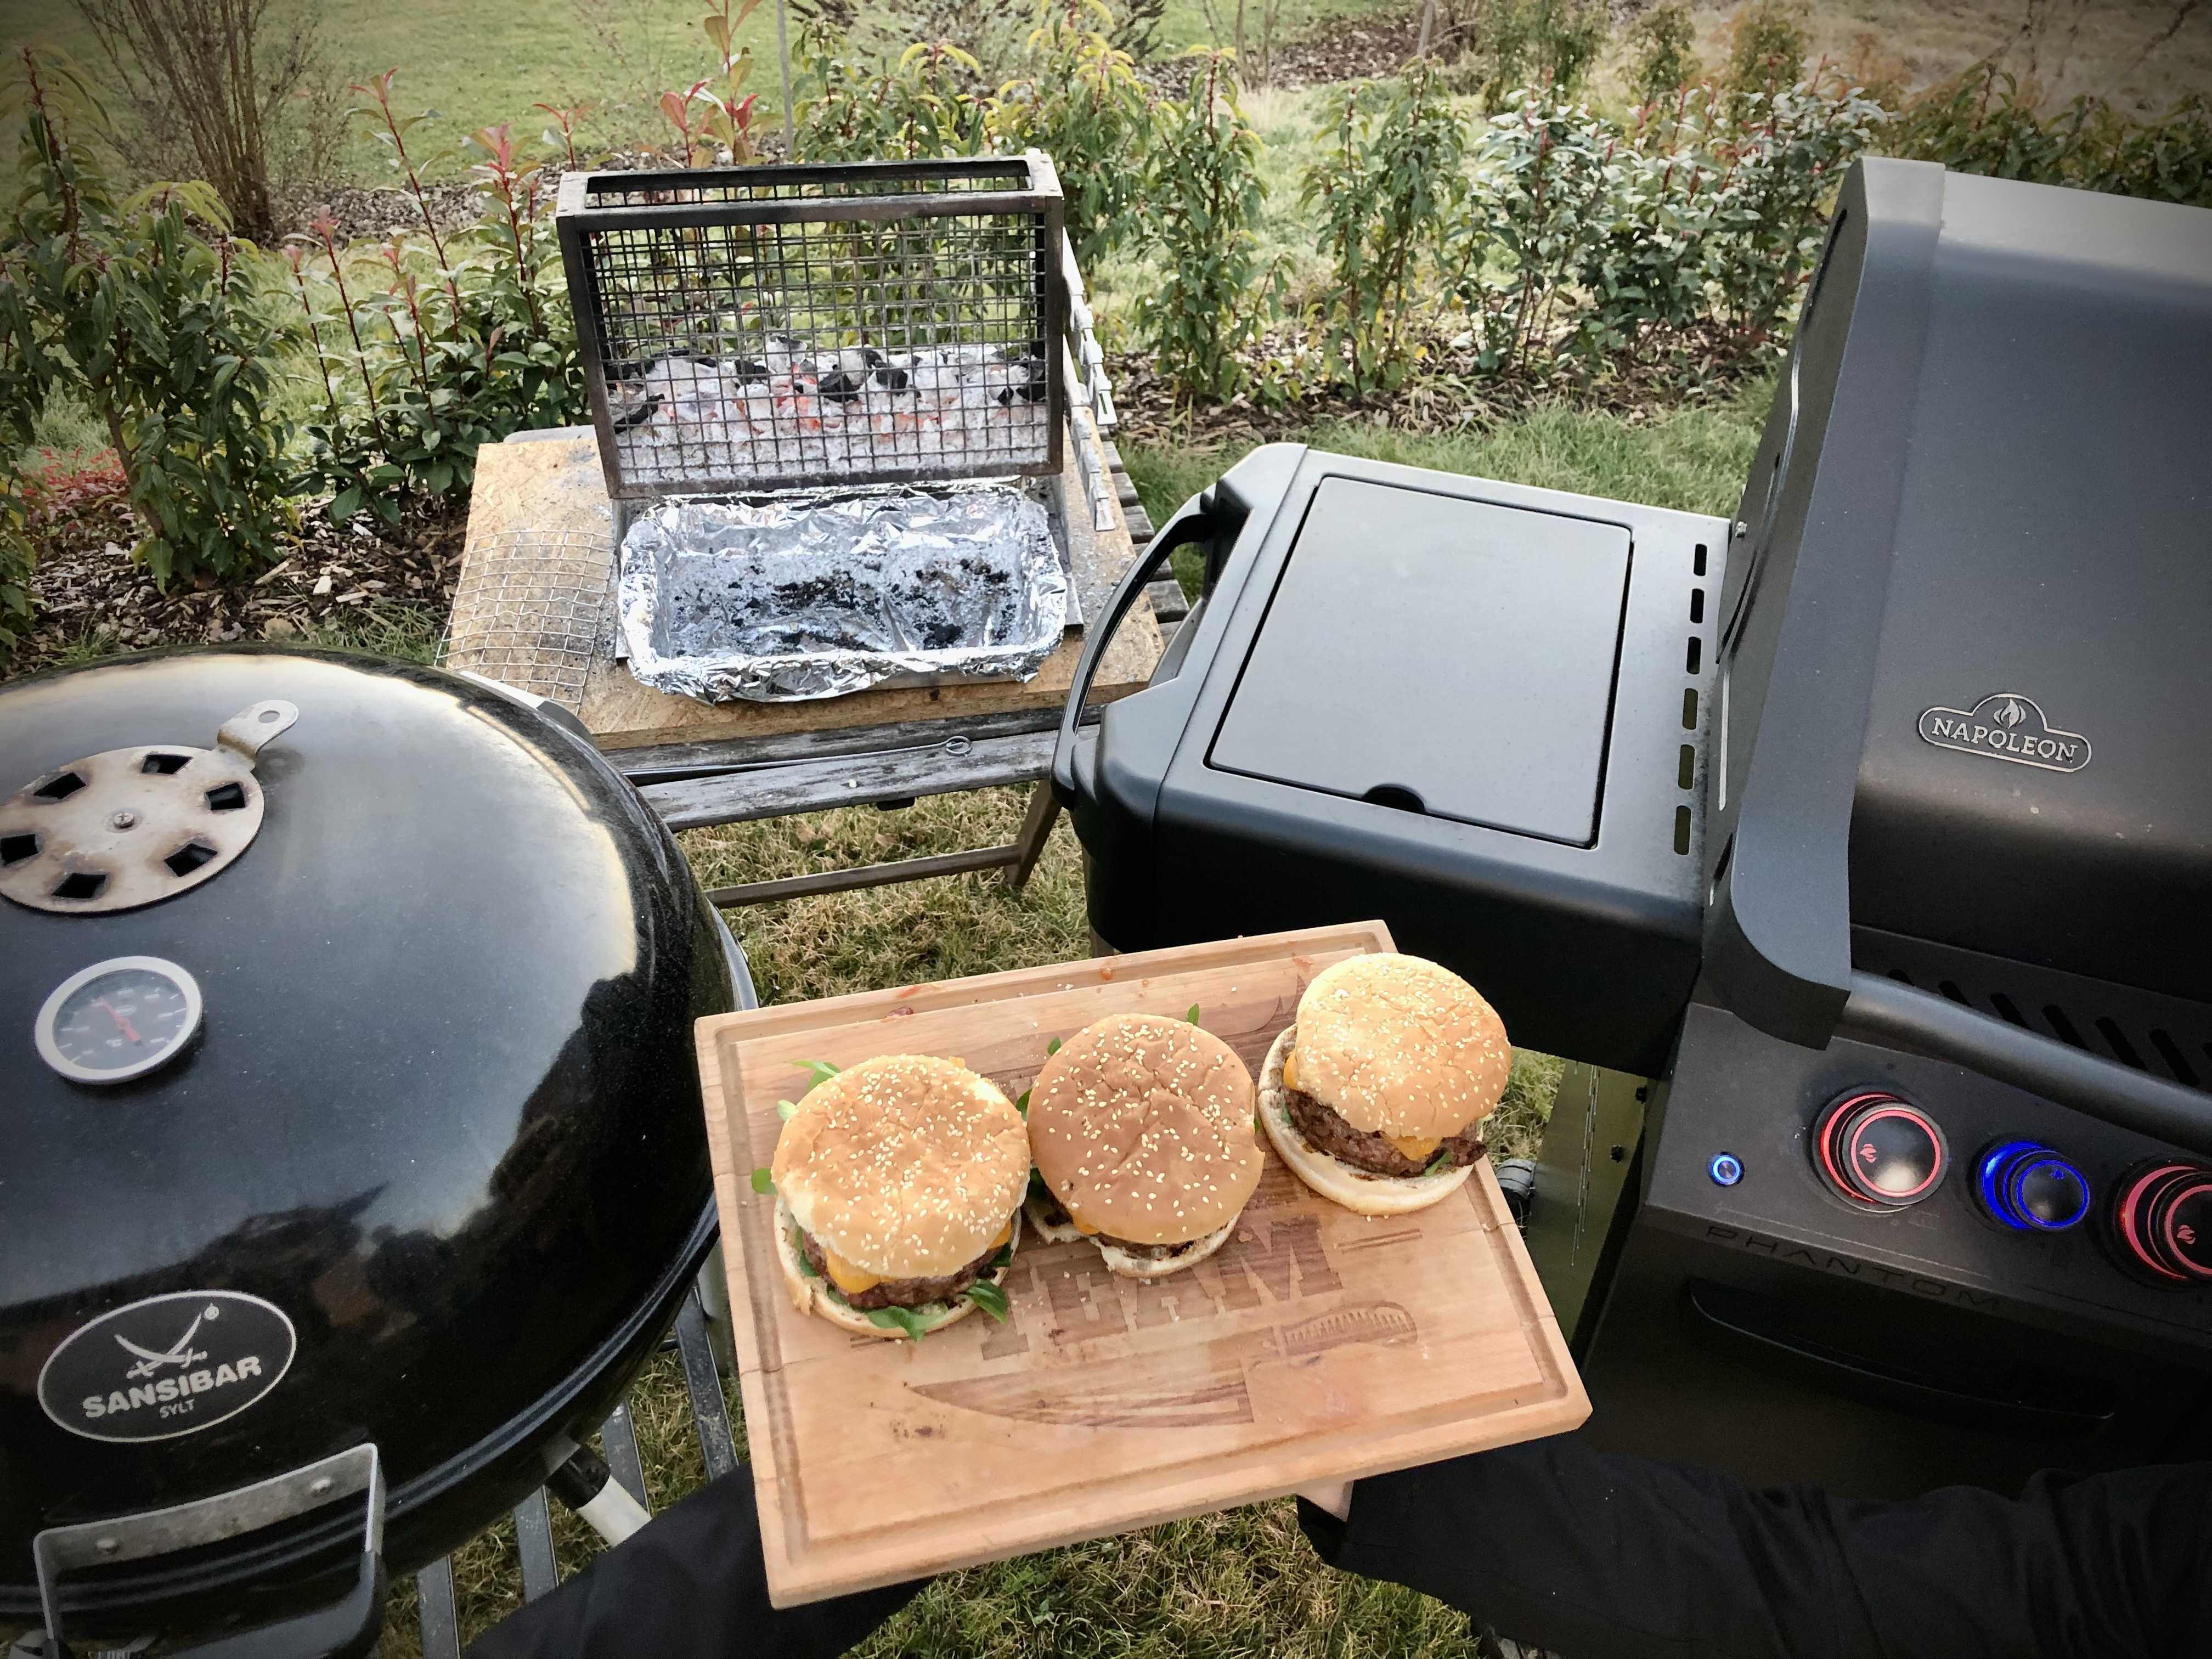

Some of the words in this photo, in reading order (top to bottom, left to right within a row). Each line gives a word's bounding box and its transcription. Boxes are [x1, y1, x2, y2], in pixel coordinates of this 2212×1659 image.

[1931, 717, 2079, 763] NAPOLEON
[1706, 1226, 1999, 1311] PHANTOM
[82, 1356, 262, 1418] SANSIBAR
[159, 1398, 195, 1419] SYLT
